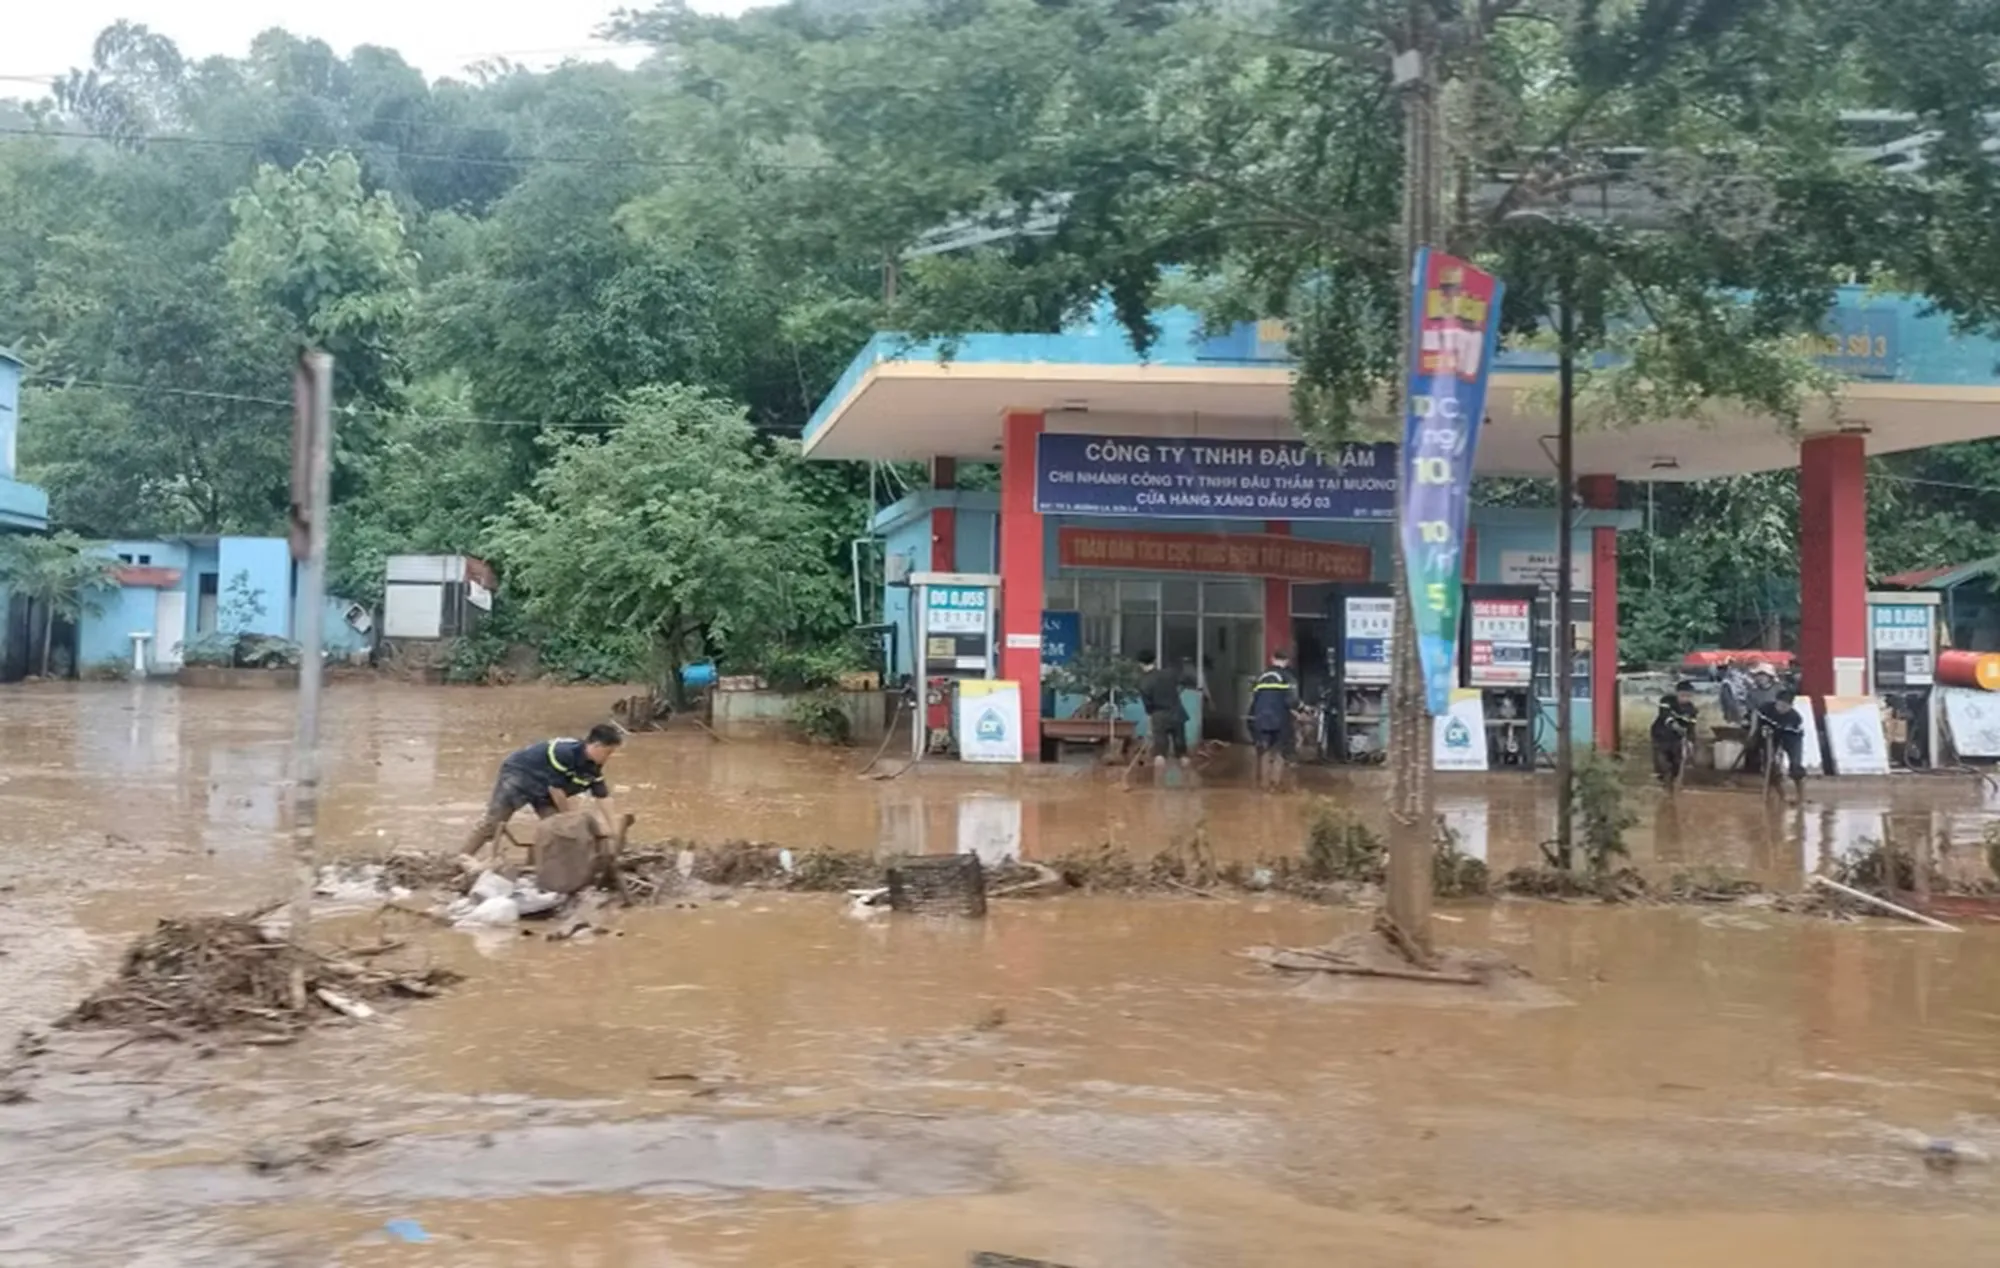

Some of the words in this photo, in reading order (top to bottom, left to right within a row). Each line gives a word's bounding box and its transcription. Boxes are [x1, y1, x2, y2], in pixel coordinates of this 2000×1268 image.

[1085, 439, 1150, 464] CÔNG
[1156, 447, 1185, 464] TY
[1191, 447, 1252, 466] TNHH
[1048, 470, 1074, 484] CHI
[1076, 470, 1128, 485] NHÁNH
[1130, 472, 1172, 487] CÔNG
[1175, 475, 1195, 487] TY
[1198, 476, 1237, 488] TNHH
[1318, 478, 1340, 491] TẠI
[1136, 489, 1167, 505] CỬA
[1169, 493, 1211, 506] HÀNG
[1291, 492, 1312, 509] SỐ
[1314, 496, 1331, 508] 03
